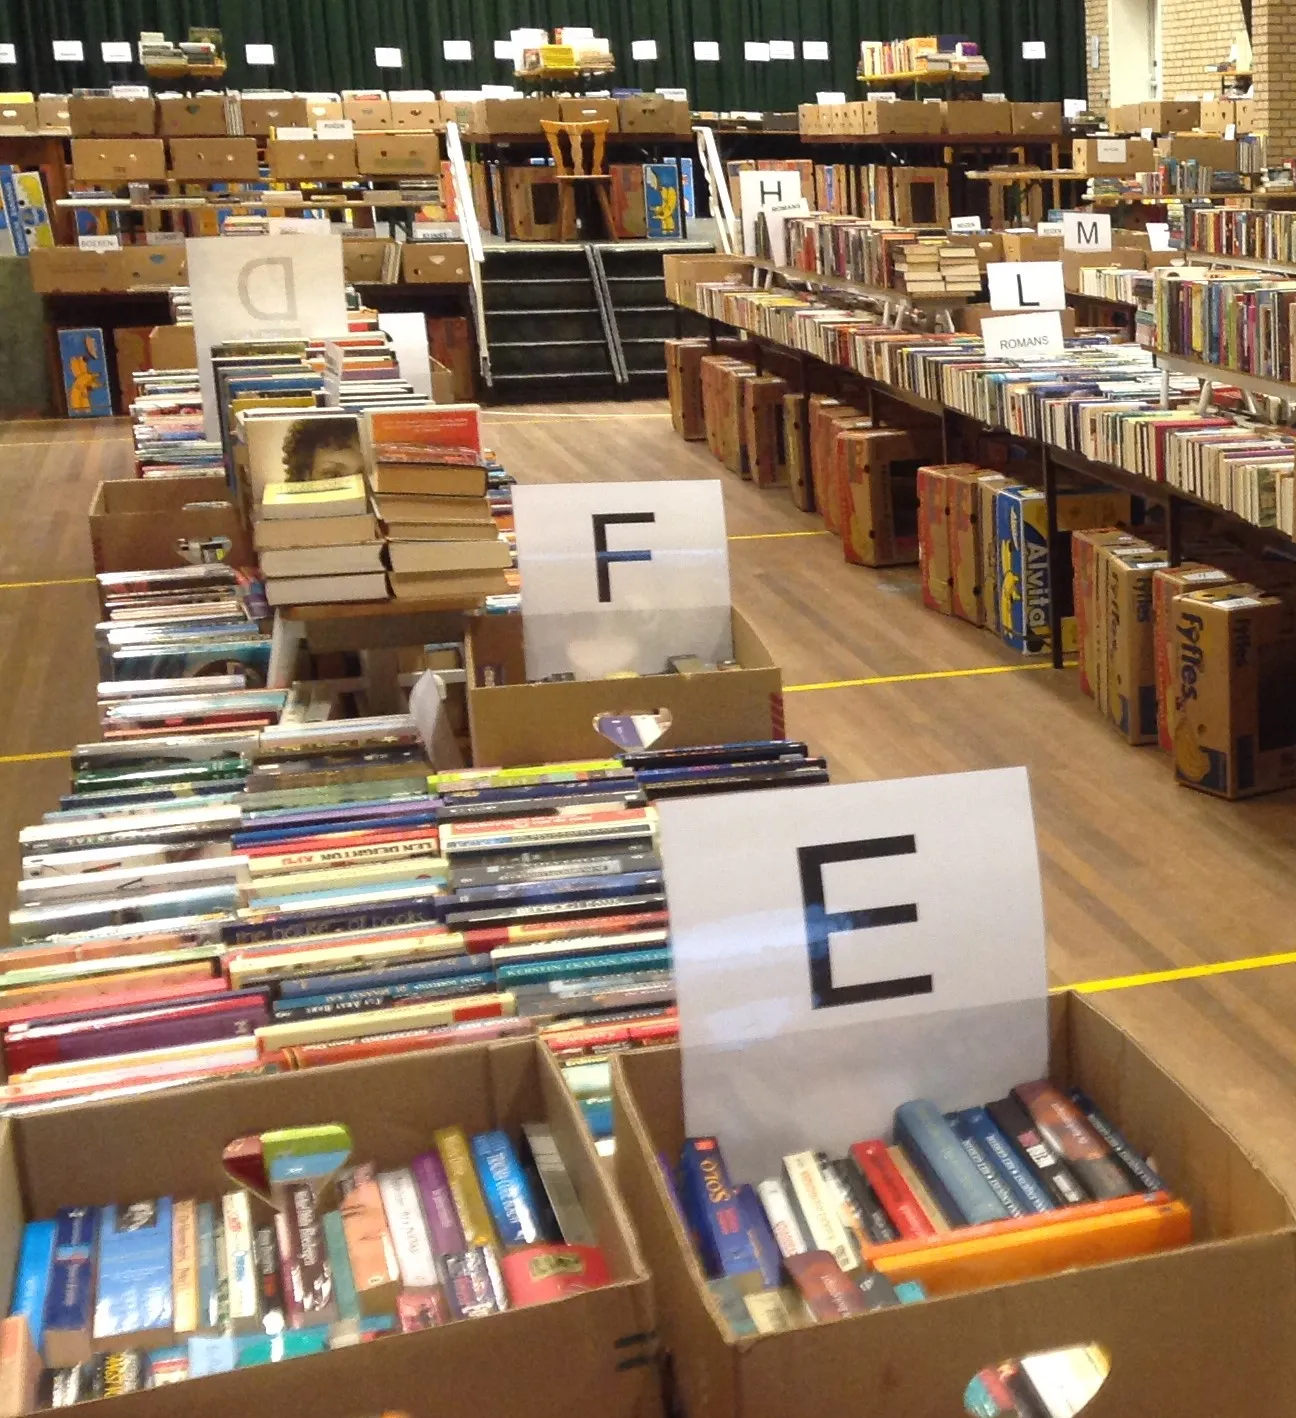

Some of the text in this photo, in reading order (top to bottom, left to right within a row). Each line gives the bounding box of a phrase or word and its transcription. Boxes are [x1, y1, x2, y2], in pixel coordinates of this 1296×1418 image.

[760, 180, 783, 206] H
[1077, 221, 1099, 245] M
[1016, 273, 1040, 307] L
[999, 336, 1049, 351] ROMANS
[592, 512, 655, 603] F
[1027, 542, 1050, 627] Alvita
[797, 833, 933, 1010] E
[700, 1159, 731, 1204] SOLO
